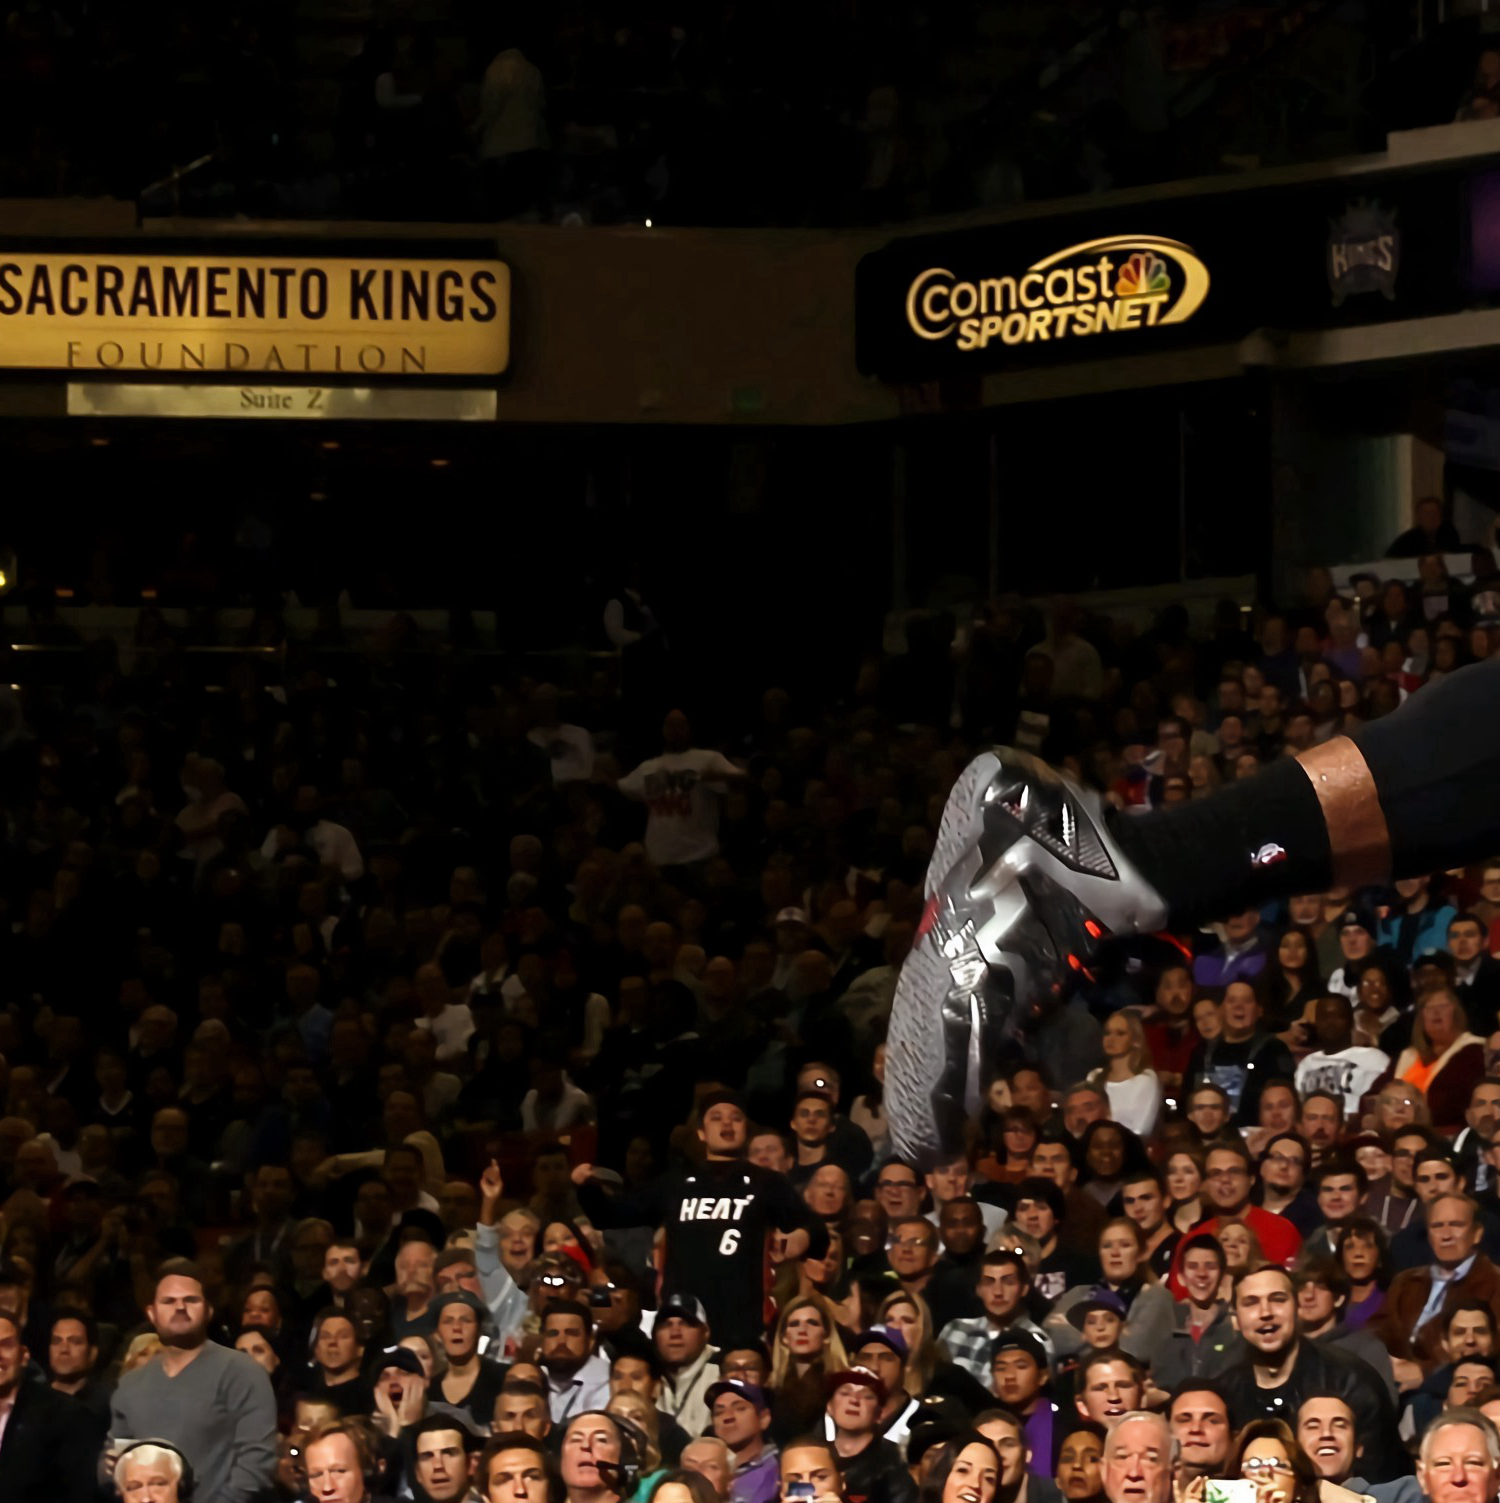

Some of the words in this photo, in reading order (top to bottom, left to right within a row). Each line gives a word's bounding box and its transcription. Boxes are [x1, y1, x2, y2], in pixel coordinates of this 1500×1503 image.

[349, 269, 497, 324] KINGS
[955, 293, 1171, 352] SPORTSNET
[66, 341, 426, 373] FOUNDATION
[239, 388, 293, 412] Suite
[680, 1194, 754, 1222] HEAT
[718, 1228, 742, 1256] 6
